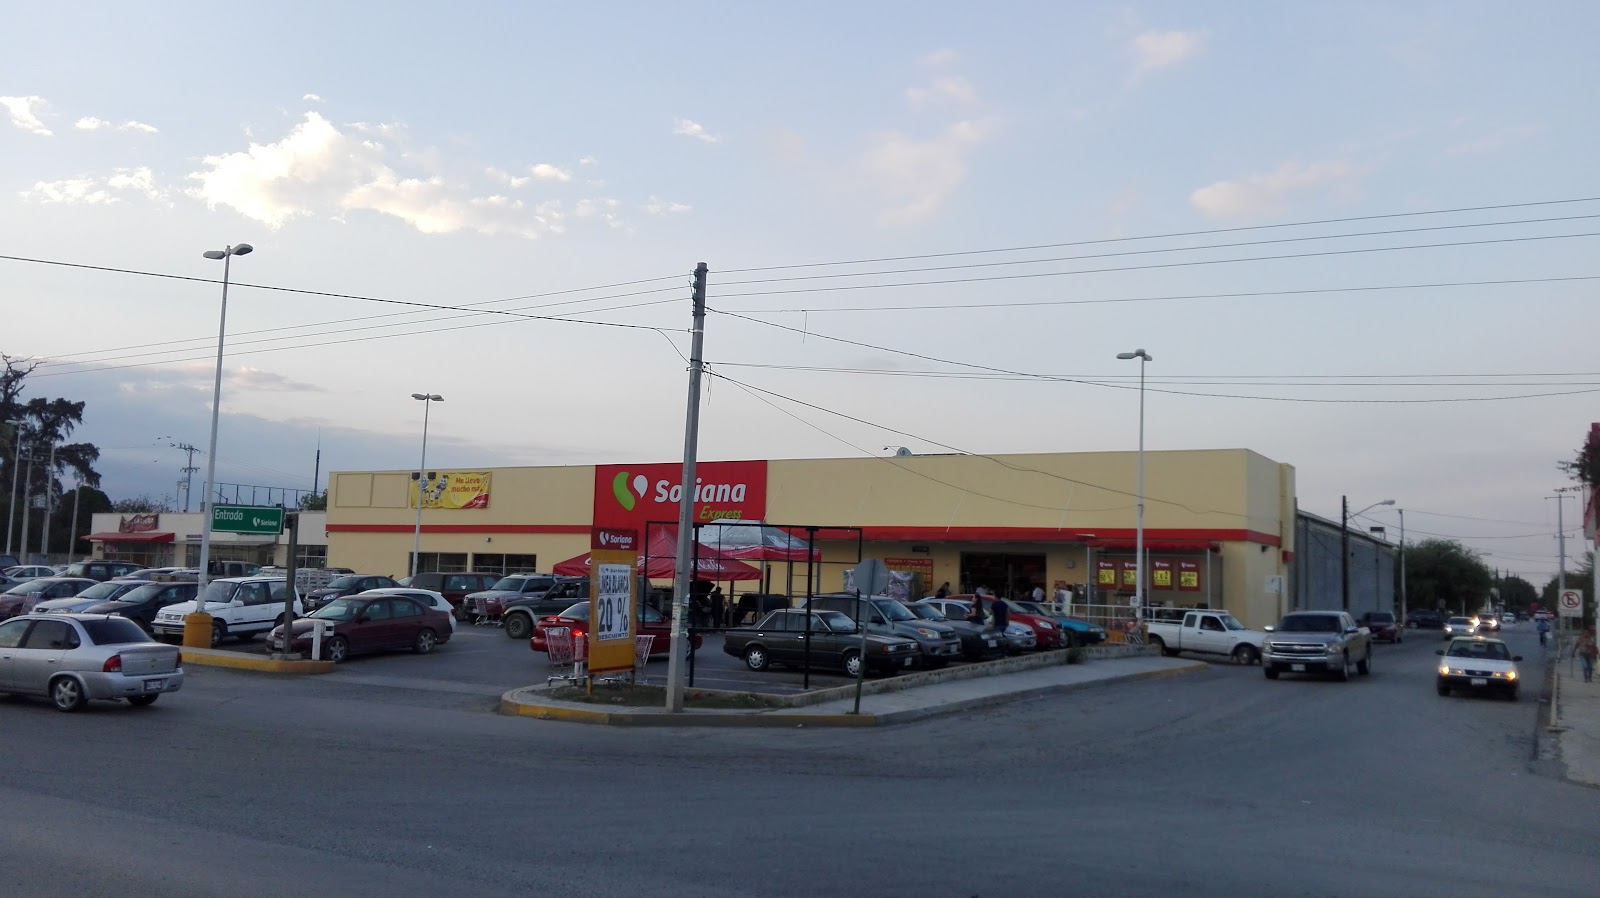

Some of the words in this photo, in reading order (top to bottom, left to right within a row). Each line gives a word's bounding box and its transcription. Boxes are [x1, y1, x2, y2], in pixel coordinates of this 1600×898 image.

[654, 477, 747, 503] Soiana
[214, 509, 243, 520] Entrada
[700, 505, 742, 519] Express
[610, 535, 632, 544] Soriana
[598, 597, 613, 632] 20
[617, 597, 629, 632] %
